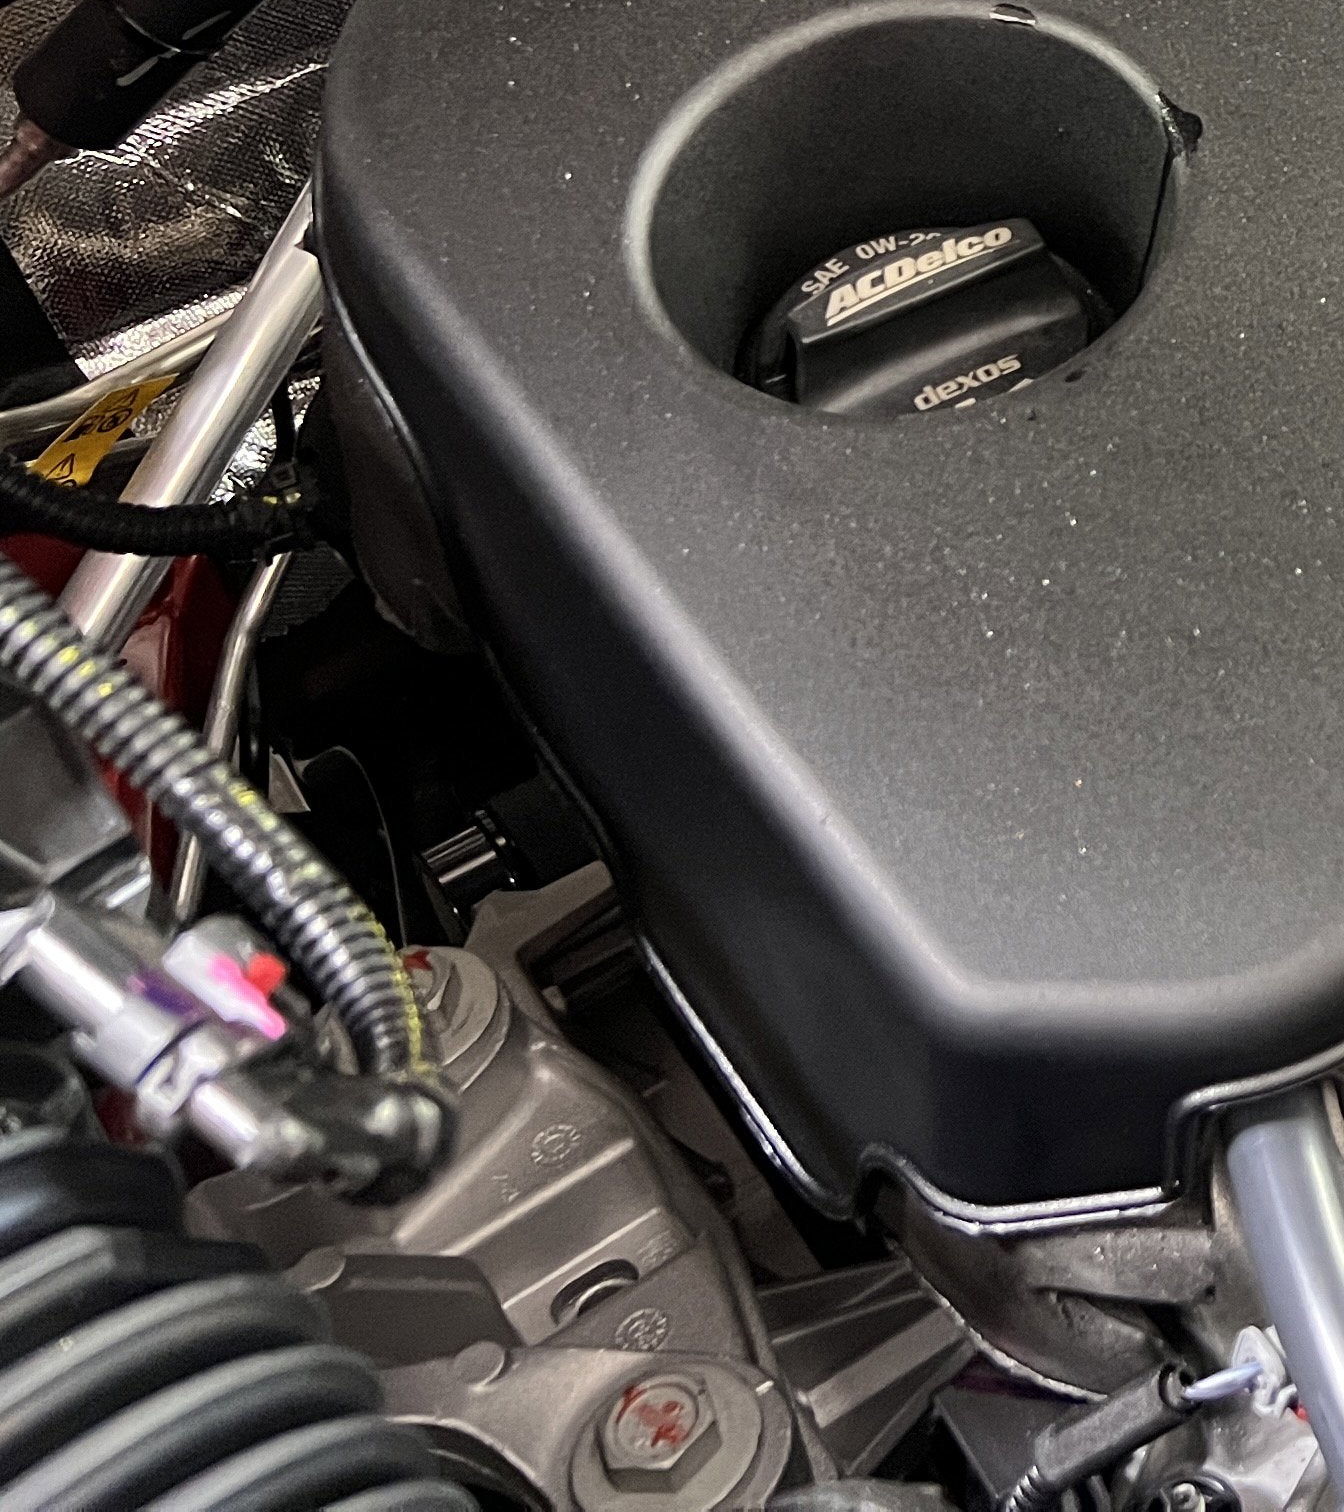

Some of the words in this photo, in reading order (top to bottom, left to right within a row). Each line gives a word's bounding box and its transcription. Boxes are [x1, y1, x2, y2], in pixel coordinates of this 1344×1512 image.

[800, 257, 850, 297] SAE
[824, 226, 1014, 322] ACDelco
[913, 353, 1022, 411] dexos
